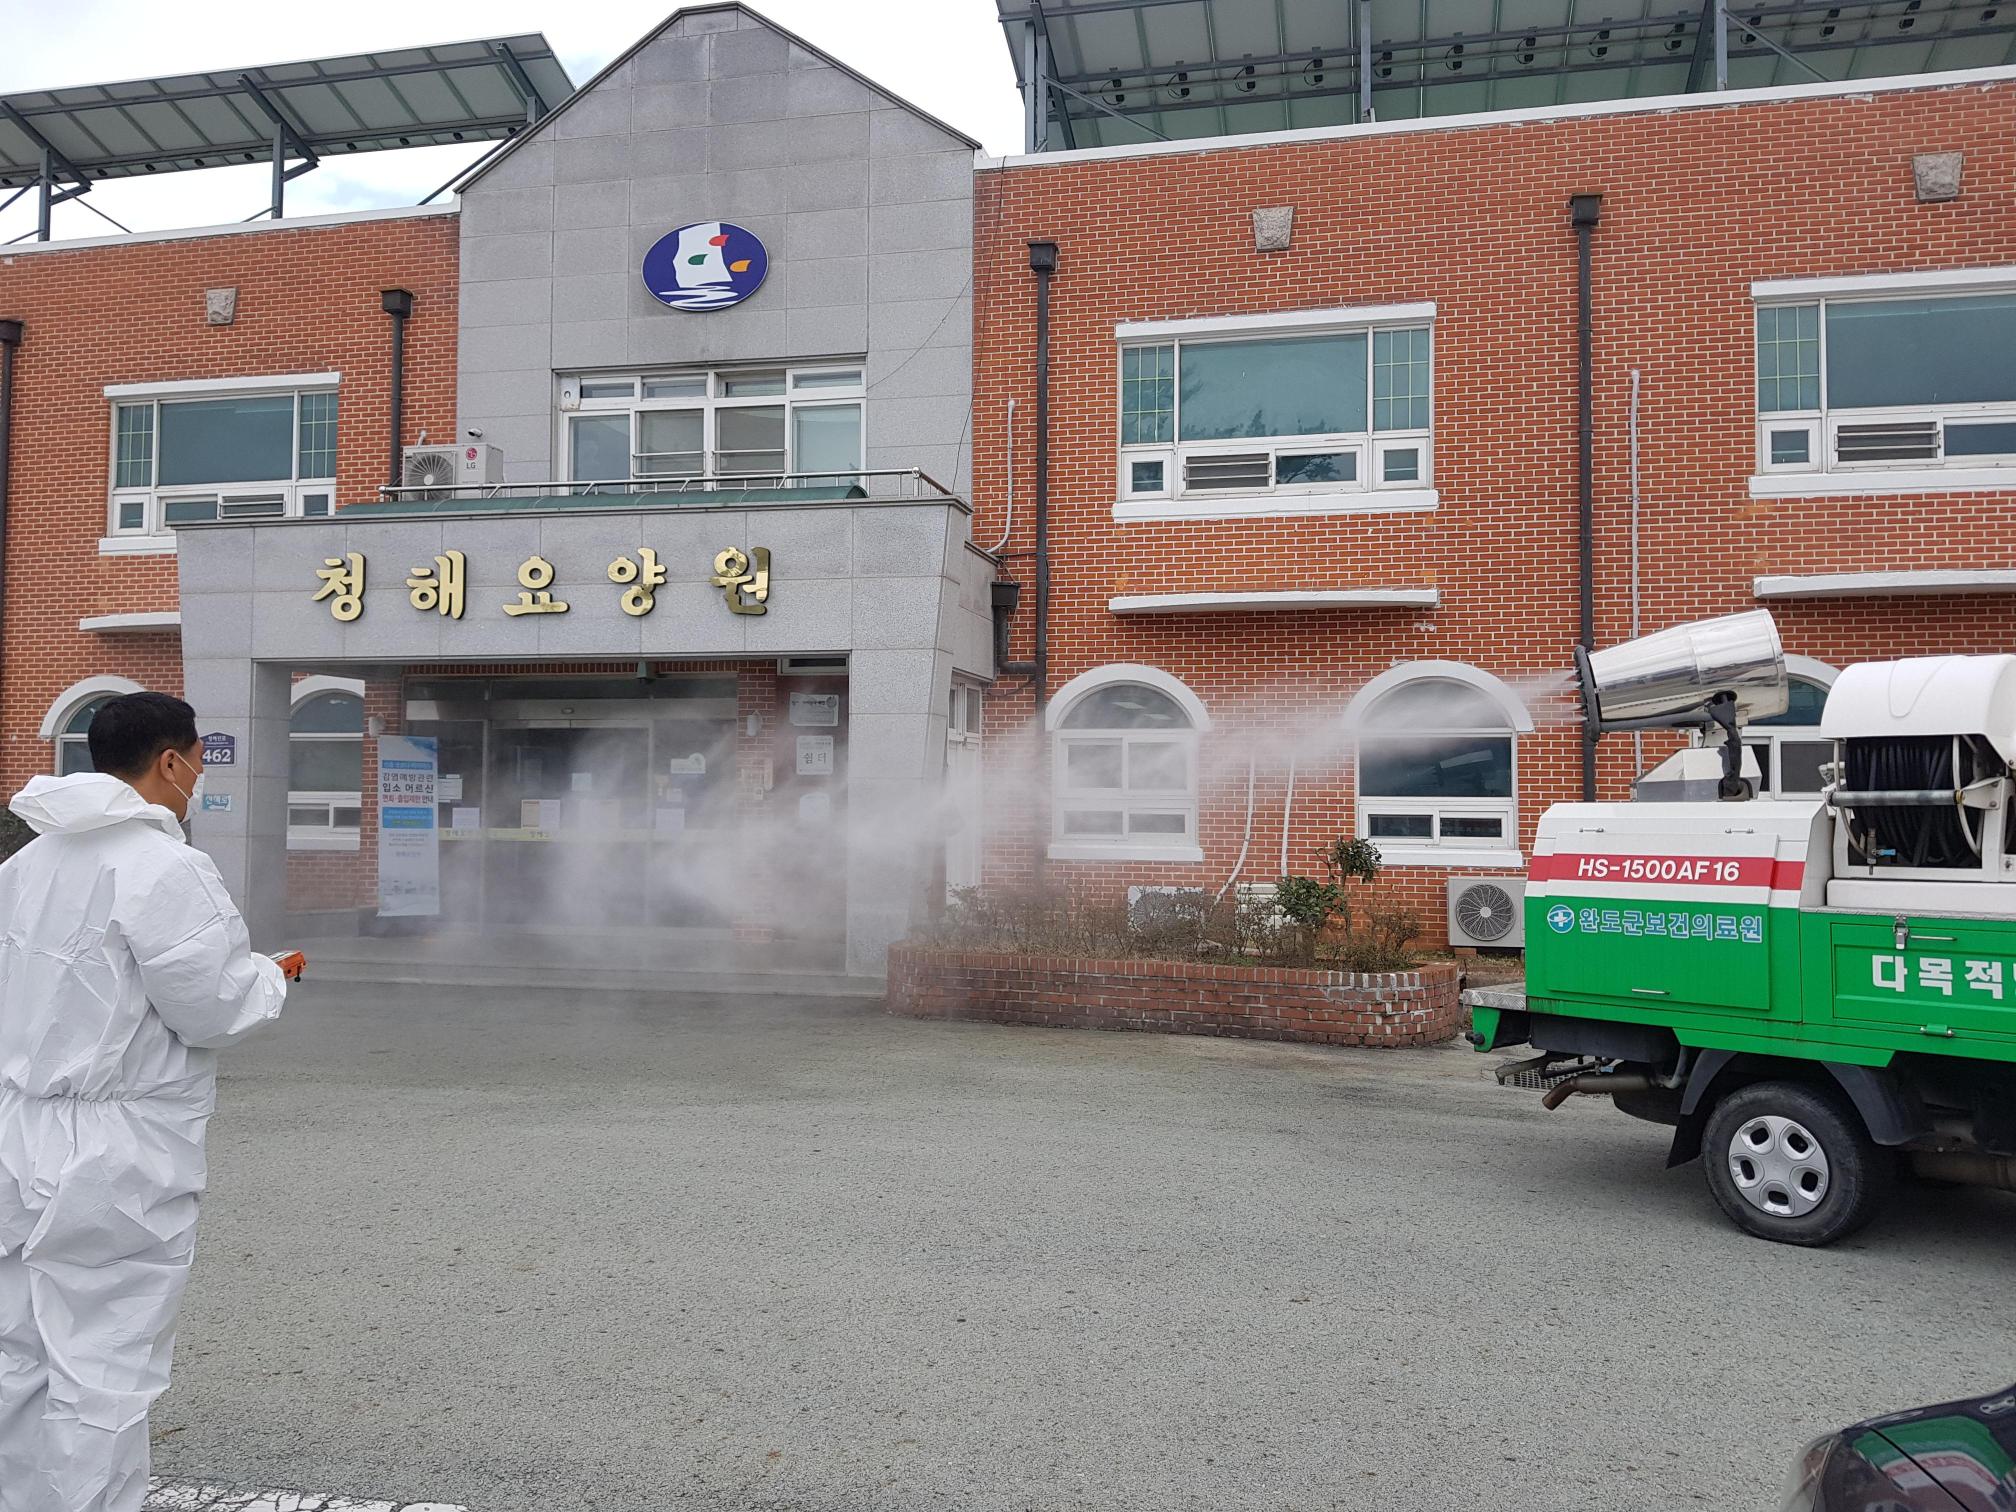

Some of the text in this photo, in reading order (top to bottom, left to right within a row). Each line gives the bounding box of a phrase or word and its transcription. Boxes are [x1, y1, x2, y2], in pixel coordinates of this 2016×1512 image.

[311, 547, 771, 621] 청해요양원
[202, 748, 231, 763] 462
[382, 783, 401, 793] 입소
[405, 783, 434, 794] 어르신
[1579, 908, 1763, 943] 완도군보건의료원
[1872, 954, 2016, 1000] 다목적
